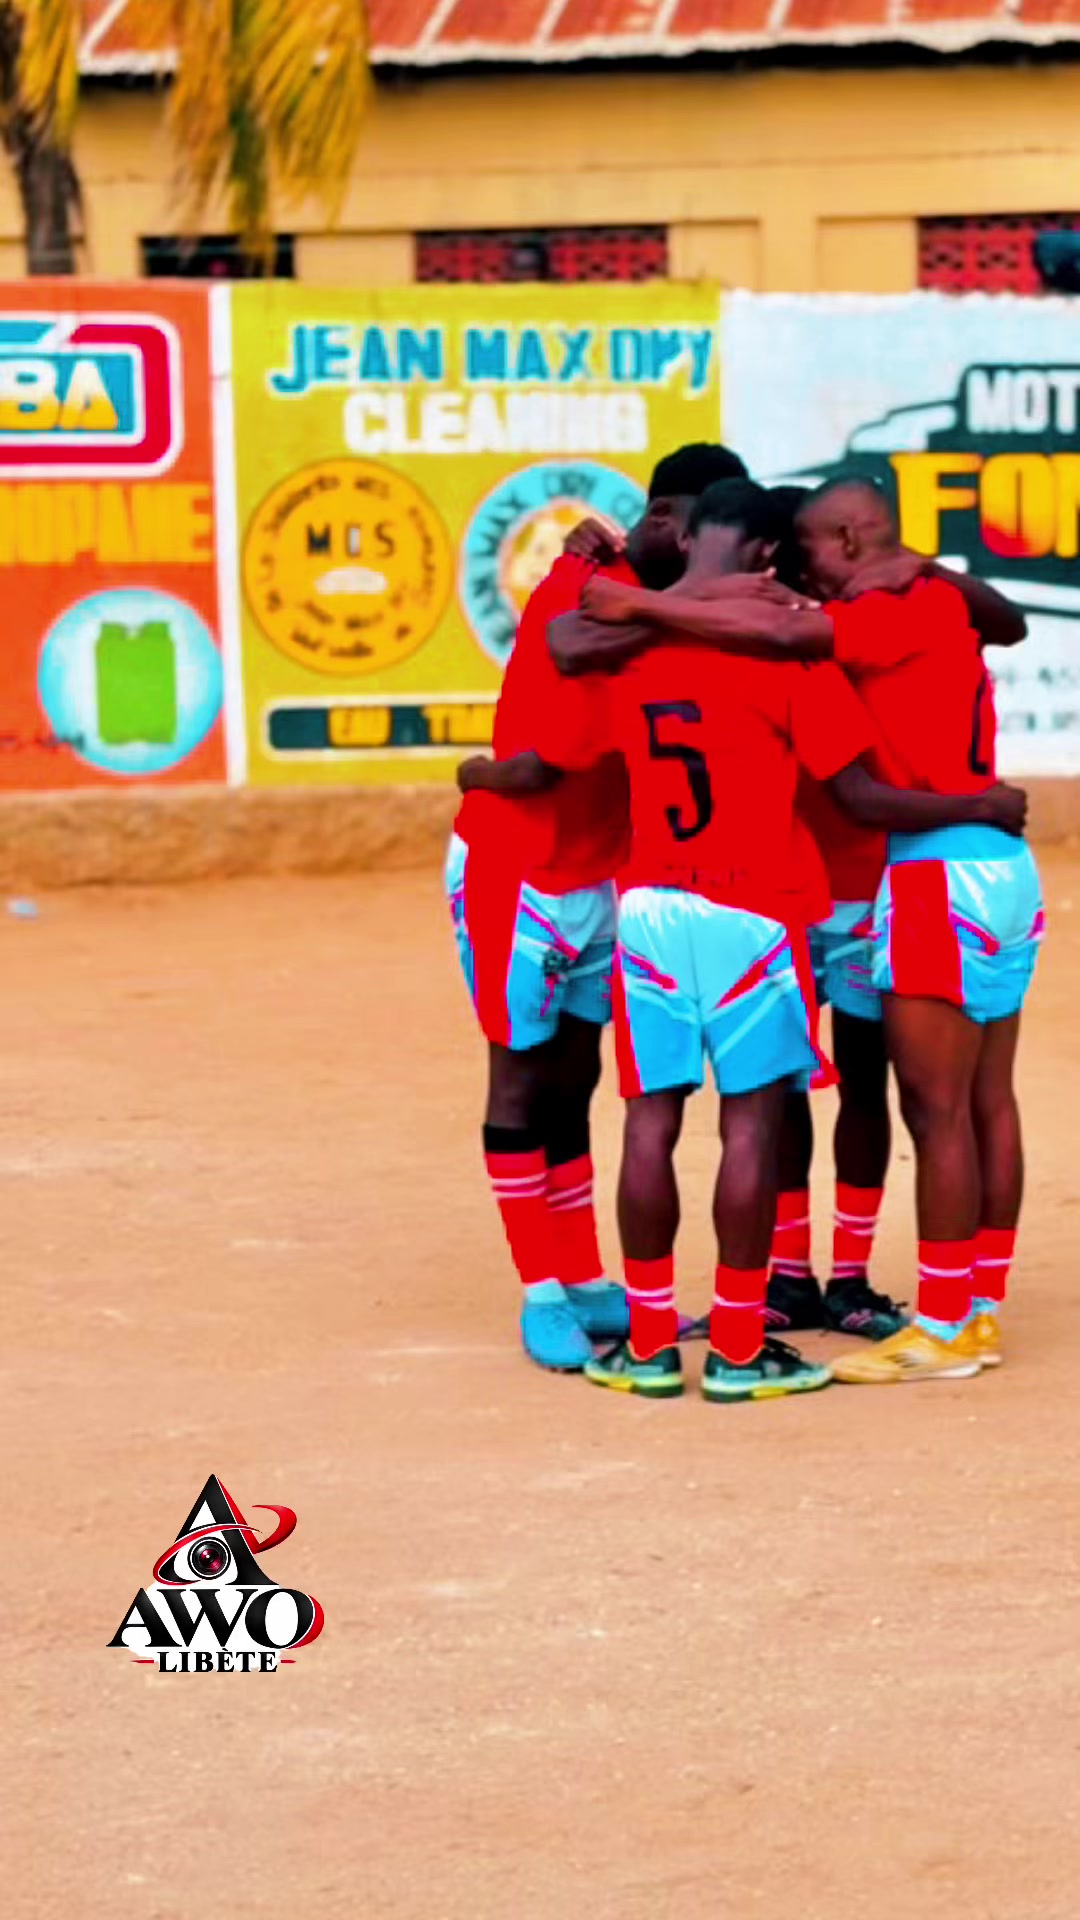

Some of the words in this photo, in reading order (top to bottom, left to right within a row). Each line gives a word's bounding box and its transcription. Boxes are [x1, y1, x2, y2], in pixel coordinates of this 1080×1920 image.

[271, 324, 442, 393] JEAN
[466, 328, 592, 383] MAX
[640, 698, 715, 842] 5
